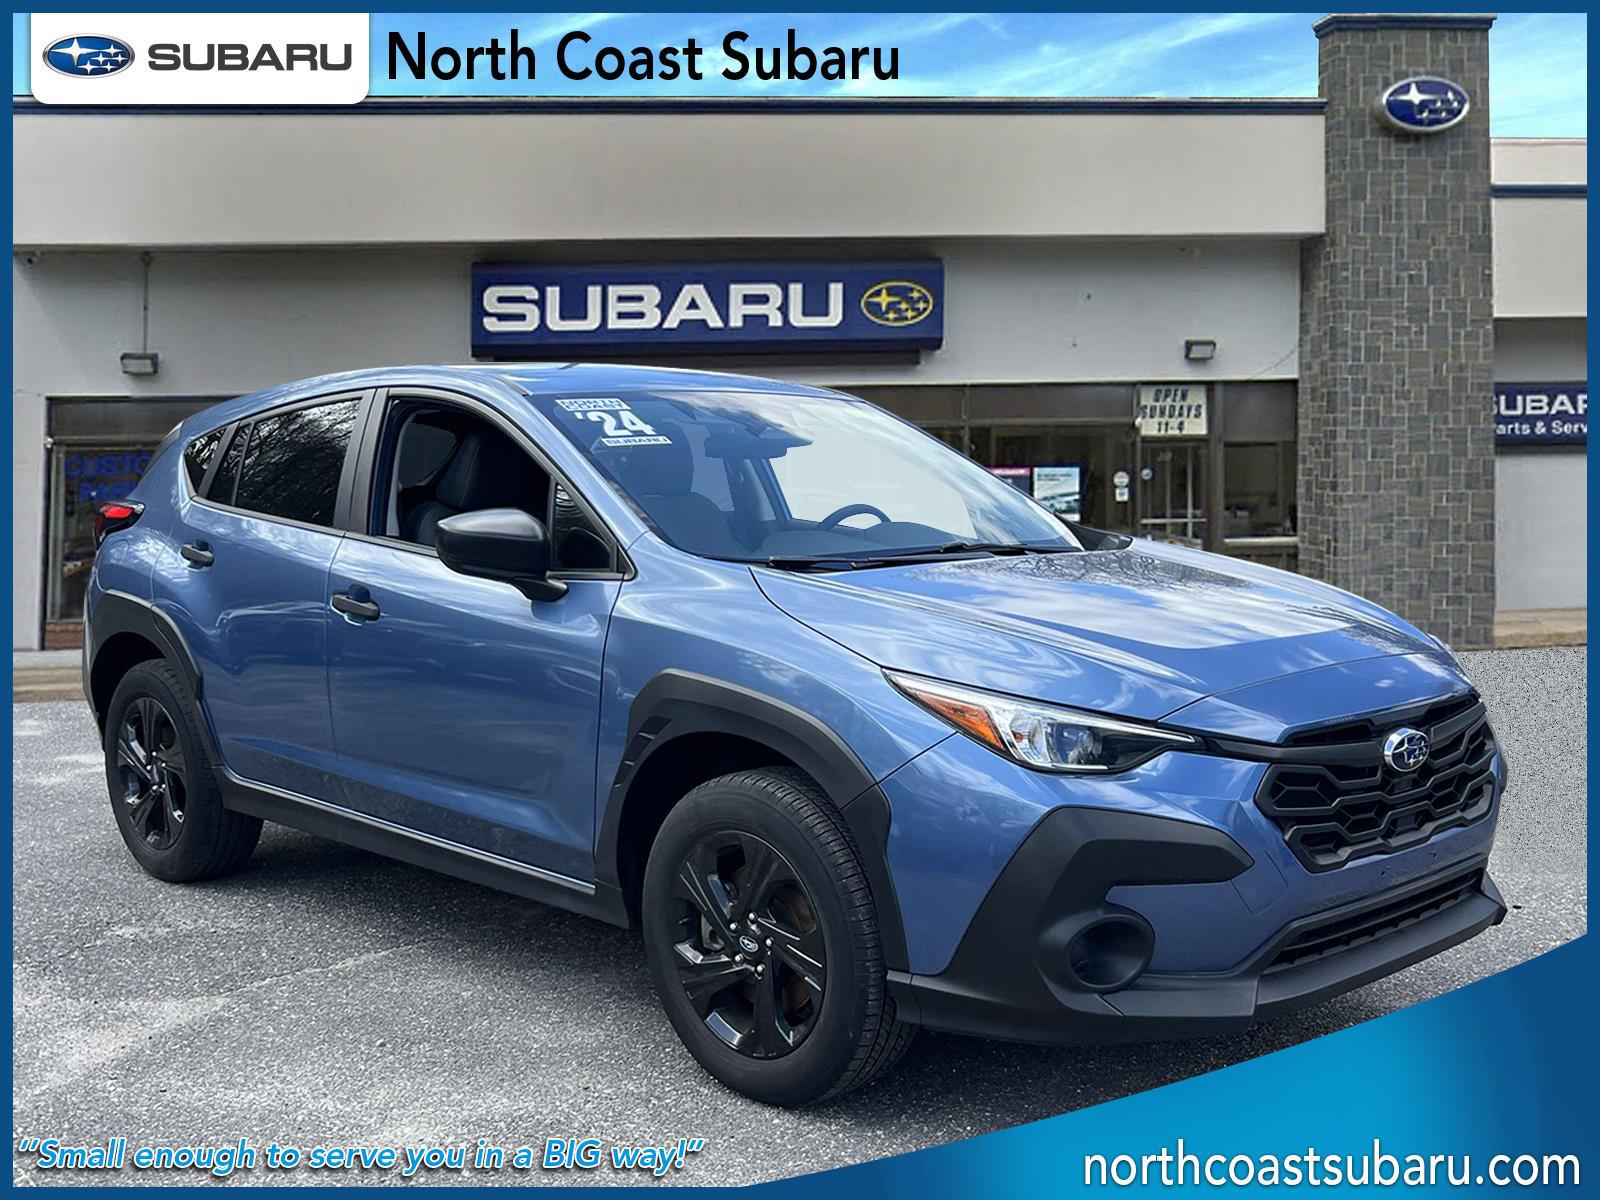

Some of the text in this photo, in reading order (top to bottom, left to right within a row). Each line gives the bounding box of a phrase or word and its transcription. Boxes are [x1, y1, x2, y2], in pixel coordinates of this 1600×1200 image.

[482, 282, 843, 332] SUBARU
[1153, 387, 1190, 403] OPEN
[1140, 404, 1203, 419] SUNDAYS
[1493, 394, 1587, 416] UBA
[574, 410, 657, 437] '24
[1157, 420, 1185, 433] 11-4
[1493, 422, 1531, 435] arts
[1534, 420, 1547, 435] &
